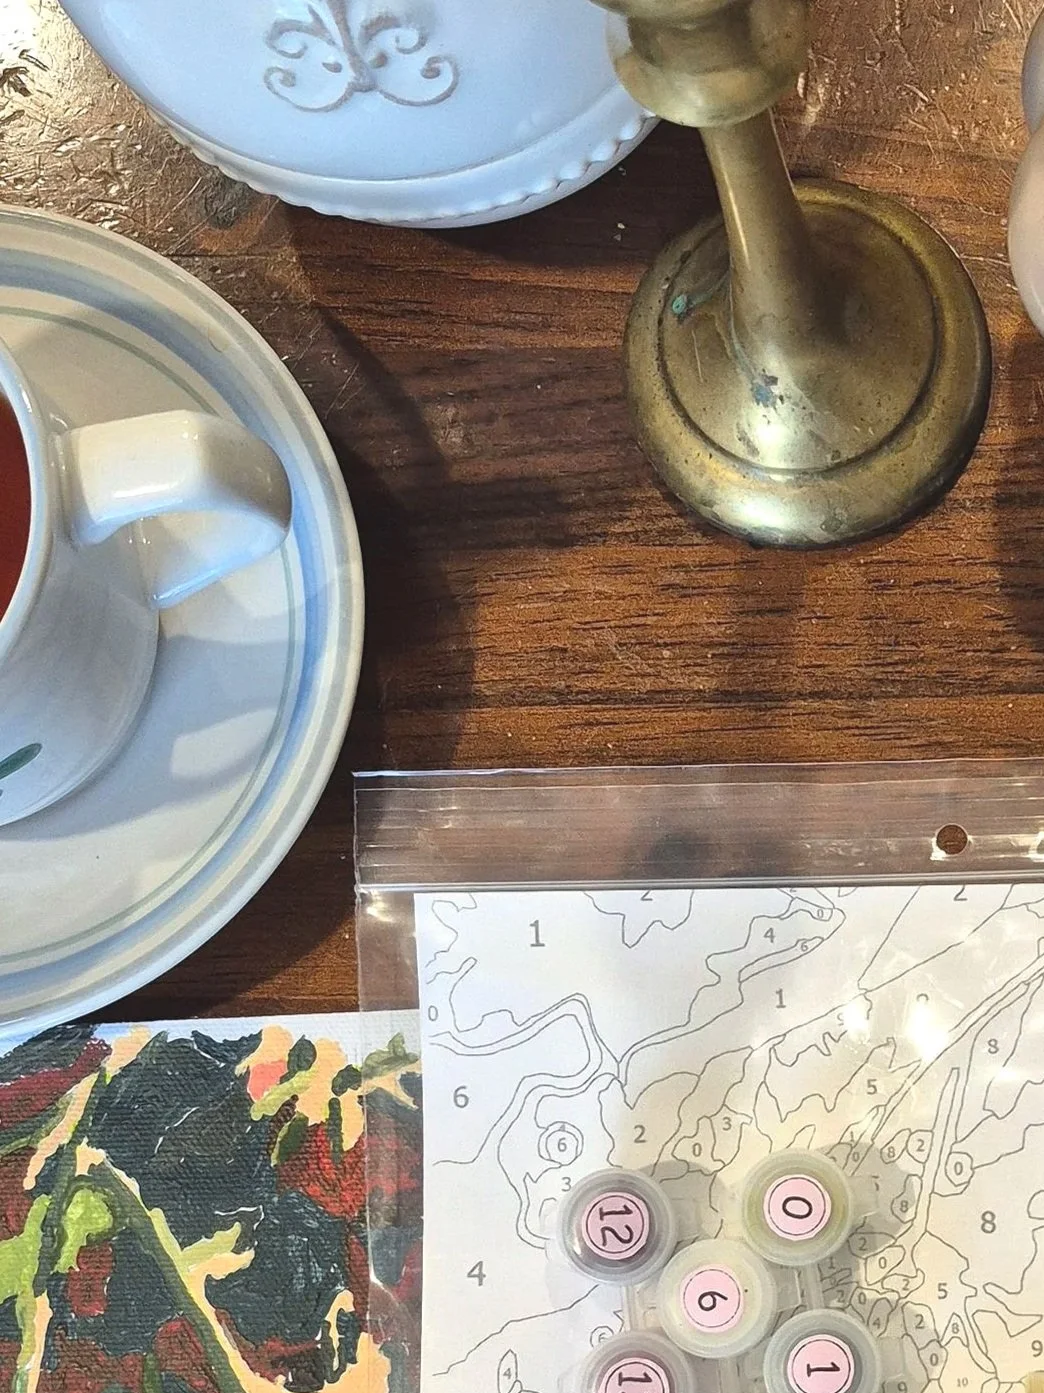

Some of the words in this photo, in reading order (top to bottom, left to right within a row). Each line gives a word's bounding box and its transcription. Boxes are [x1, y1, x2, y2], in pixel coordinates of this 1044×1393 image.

[529, 920, 545, 947] 1
[764, 928, 776, 943] 4
[801, 942, 808, 952] 6
[776, 990, 786, 1008] 1
[427, 1006, 438, 1022] 0
[988, 1039, 999, 1054] 8
[867, 1080, 877, 1095] 5
[453, 1086, 469, 1108] 6
[723, 1117, 731, 1131] 3
[634, 1126, 645, 1143] 2
[557, 1137, 567, 1153] 6
[693, 1143, 702, 1157] 0
[917, 1139, 924, 1151] 2
[954, 1161, 962, 1176] 0
[561, 1177, 572, 1192] 3
[782, 1196, 812, 1219] 0
[901, 1201, 908, 1212] 8
[599, 1205, 633, 1246] 12
[981, 1211, 996, 1233] 8
[879, 1257, 886, 1269] 0
[468, 1261, 486, 1285] 4
[903, 1279, 909, 1291] 2
[938, 1283, 947, 1299] 5
[698, 1292, 728, 1311] 6
[858, 1292, 866, 1304] 0
[916, 1315, 924, 1328] 2
[1032, 1341, 1043, 1357] 9
[930, 1353, 938, 1366] 0
[504, 1369, 511, 1379] 4
[807, 1362, 840, 1376] 1
